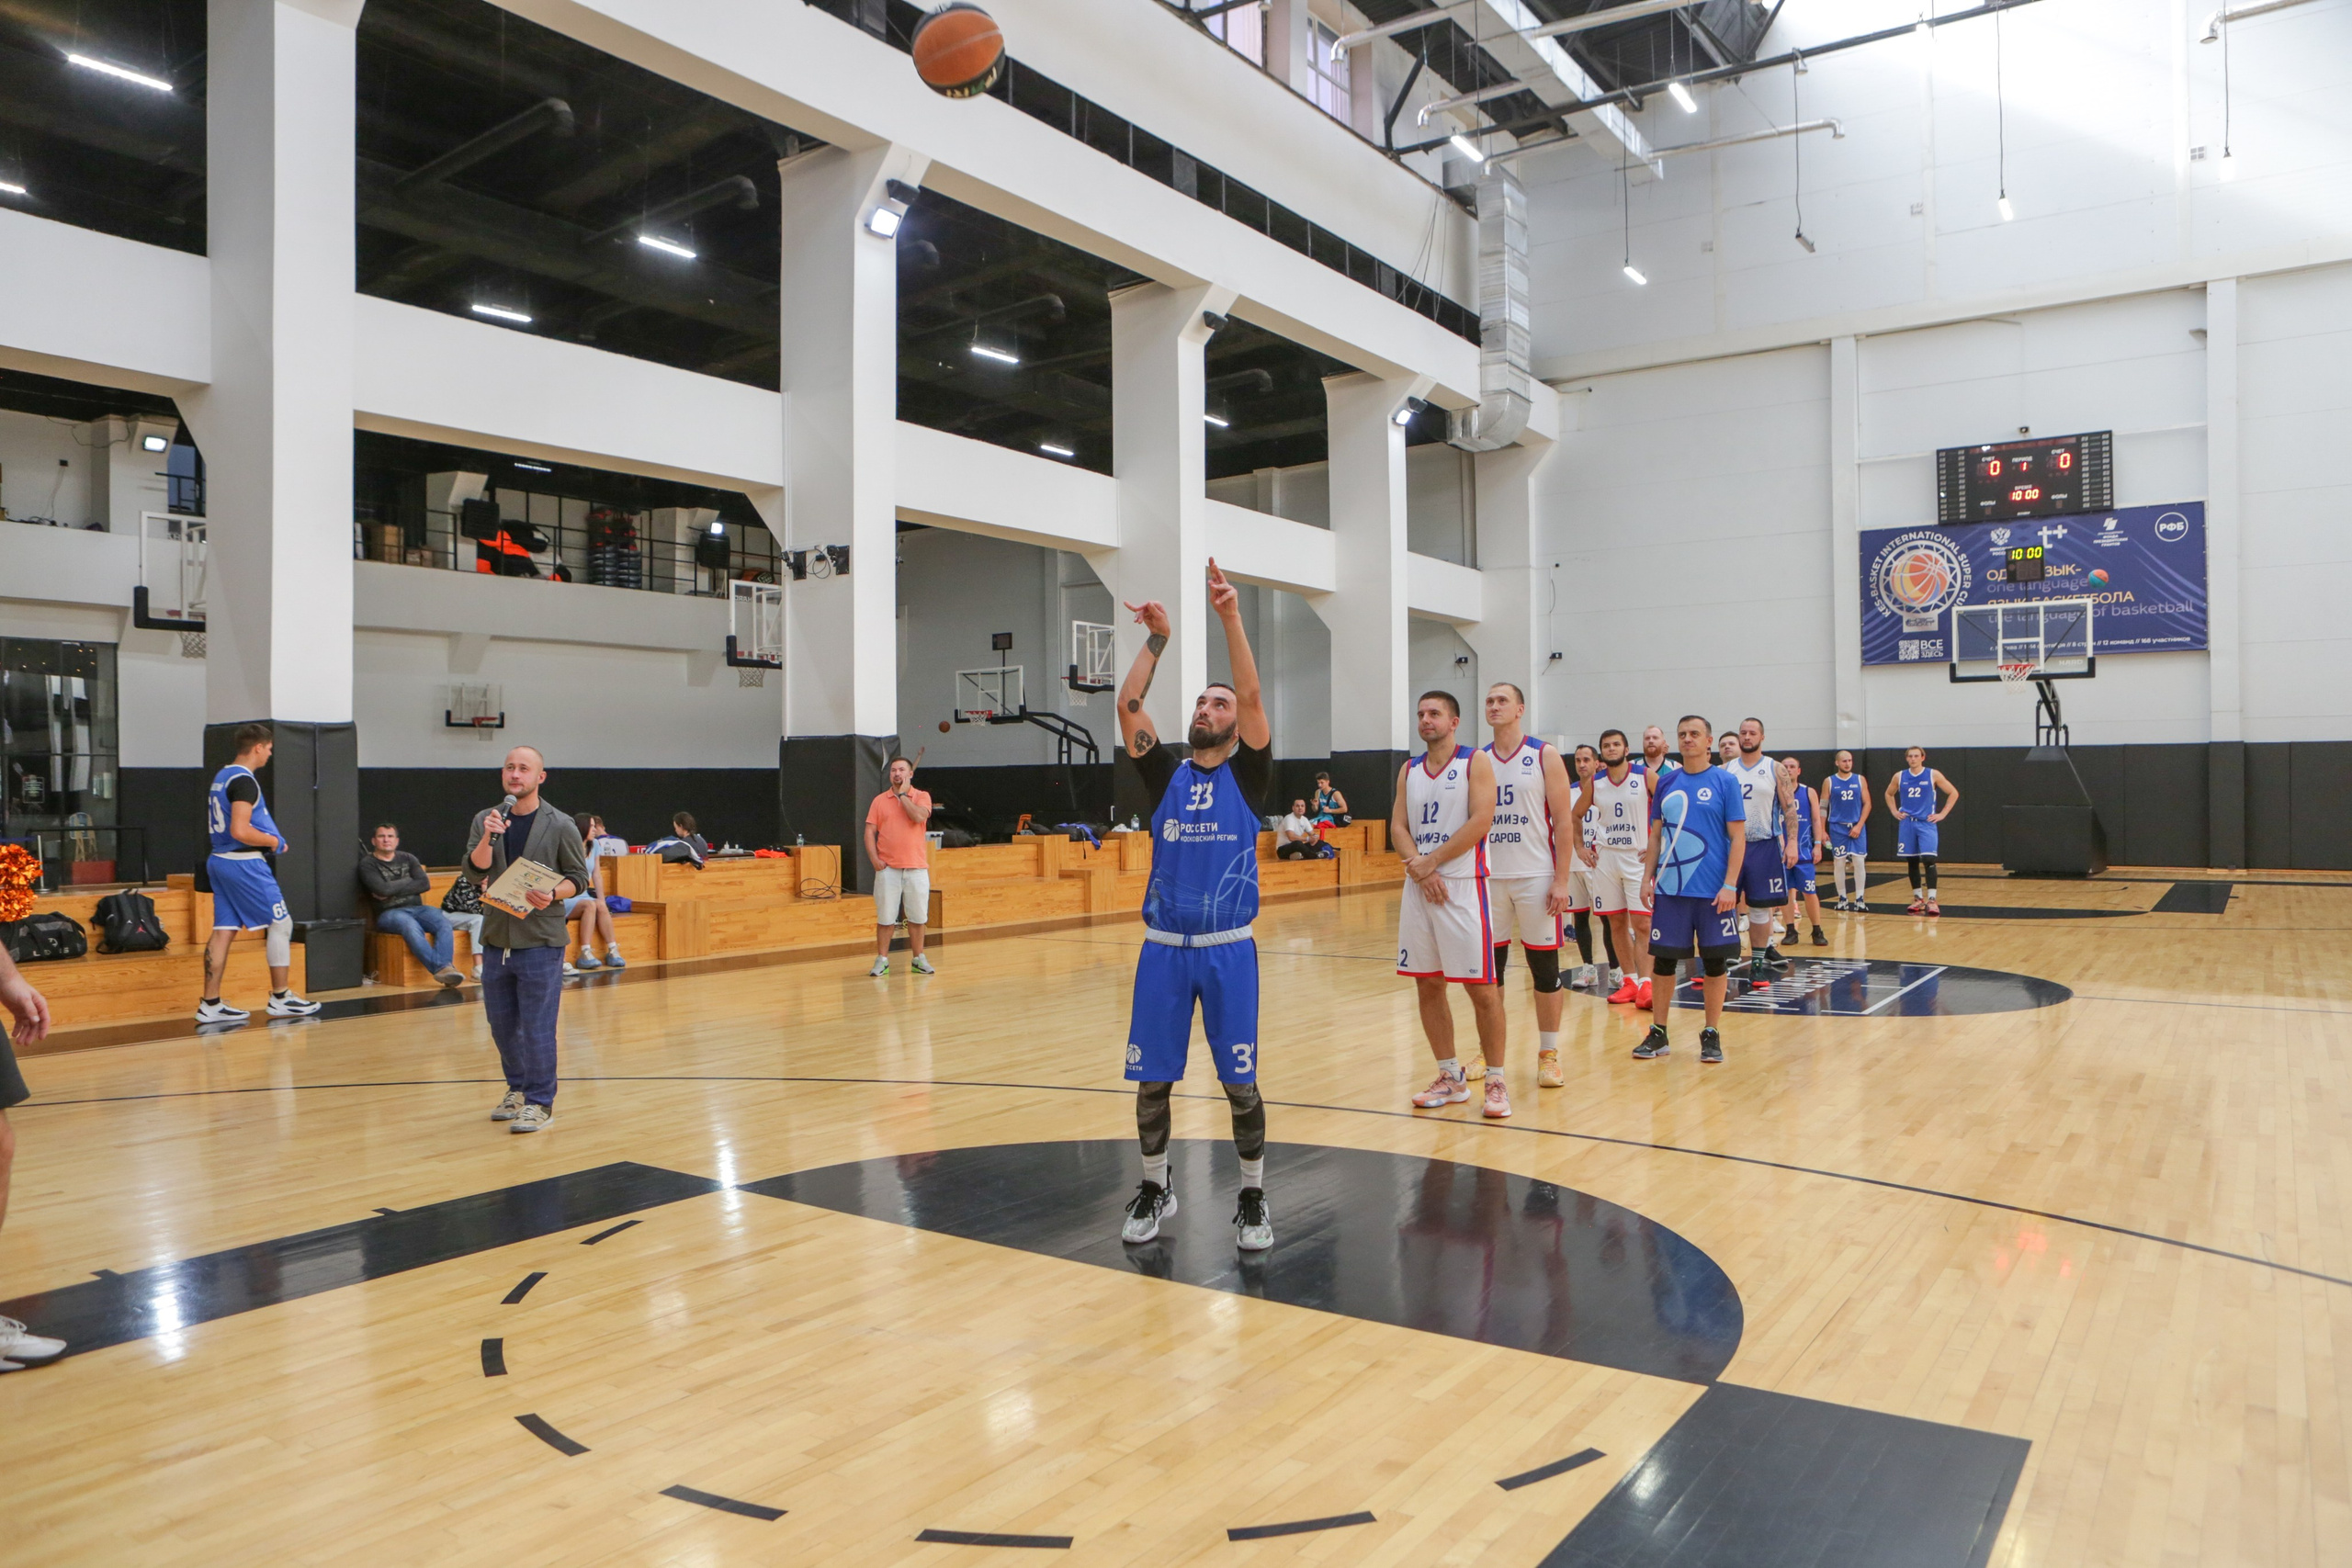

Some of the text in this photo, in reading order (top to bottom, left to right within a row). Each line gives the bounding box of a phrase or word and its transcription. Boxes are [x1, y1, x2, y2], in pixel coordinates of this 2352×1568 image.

[2022, 462, 2027, 471] 1
[2060, 453, 2071, 468] 0
[1990, 460, 2000, 476] 0
[2159, 522, 2184, 533] РФБ
[1870, 531, 1972, 617] KES-BASKET INTERNATIONAL SUPER CU
[2044, 564, 2082, 578] ЗЫК-
[1987, 583, 2015, 592] one
[2092, 605, 2107, 618] of
[2111, 599, 2194, 616] basketball
[1920, 639, 1943, 649] ВСЕ
[2077, 640, 2097, 649] стрн
[1185, 782, 1214, 810] 33
[1496, 784, 1513, 807] 15
[1741, 784, 1753, 800] 2
[1841, 790, 1854, 801] 32
[1908, 787, 1921, 797] 22
[1421, 801, 1439, 824] 12
[1614, 802, 1623, 818] 6
[1491, 814, 1529, 826] НИИЭФ
[1489, 832, 1521, 843] САРОВ
[1607, 837, 1632, 845] САРОВ
[1834, 845, 1847, 856] 32
[1770, 878, 1783, 893] 12
[1595, 897, 1602, 908] 6
[1720, 917, 1736, 937] 21
[1397, 949, 1408, 967] 2
[1232, 1043, 1254, 1074] 3
